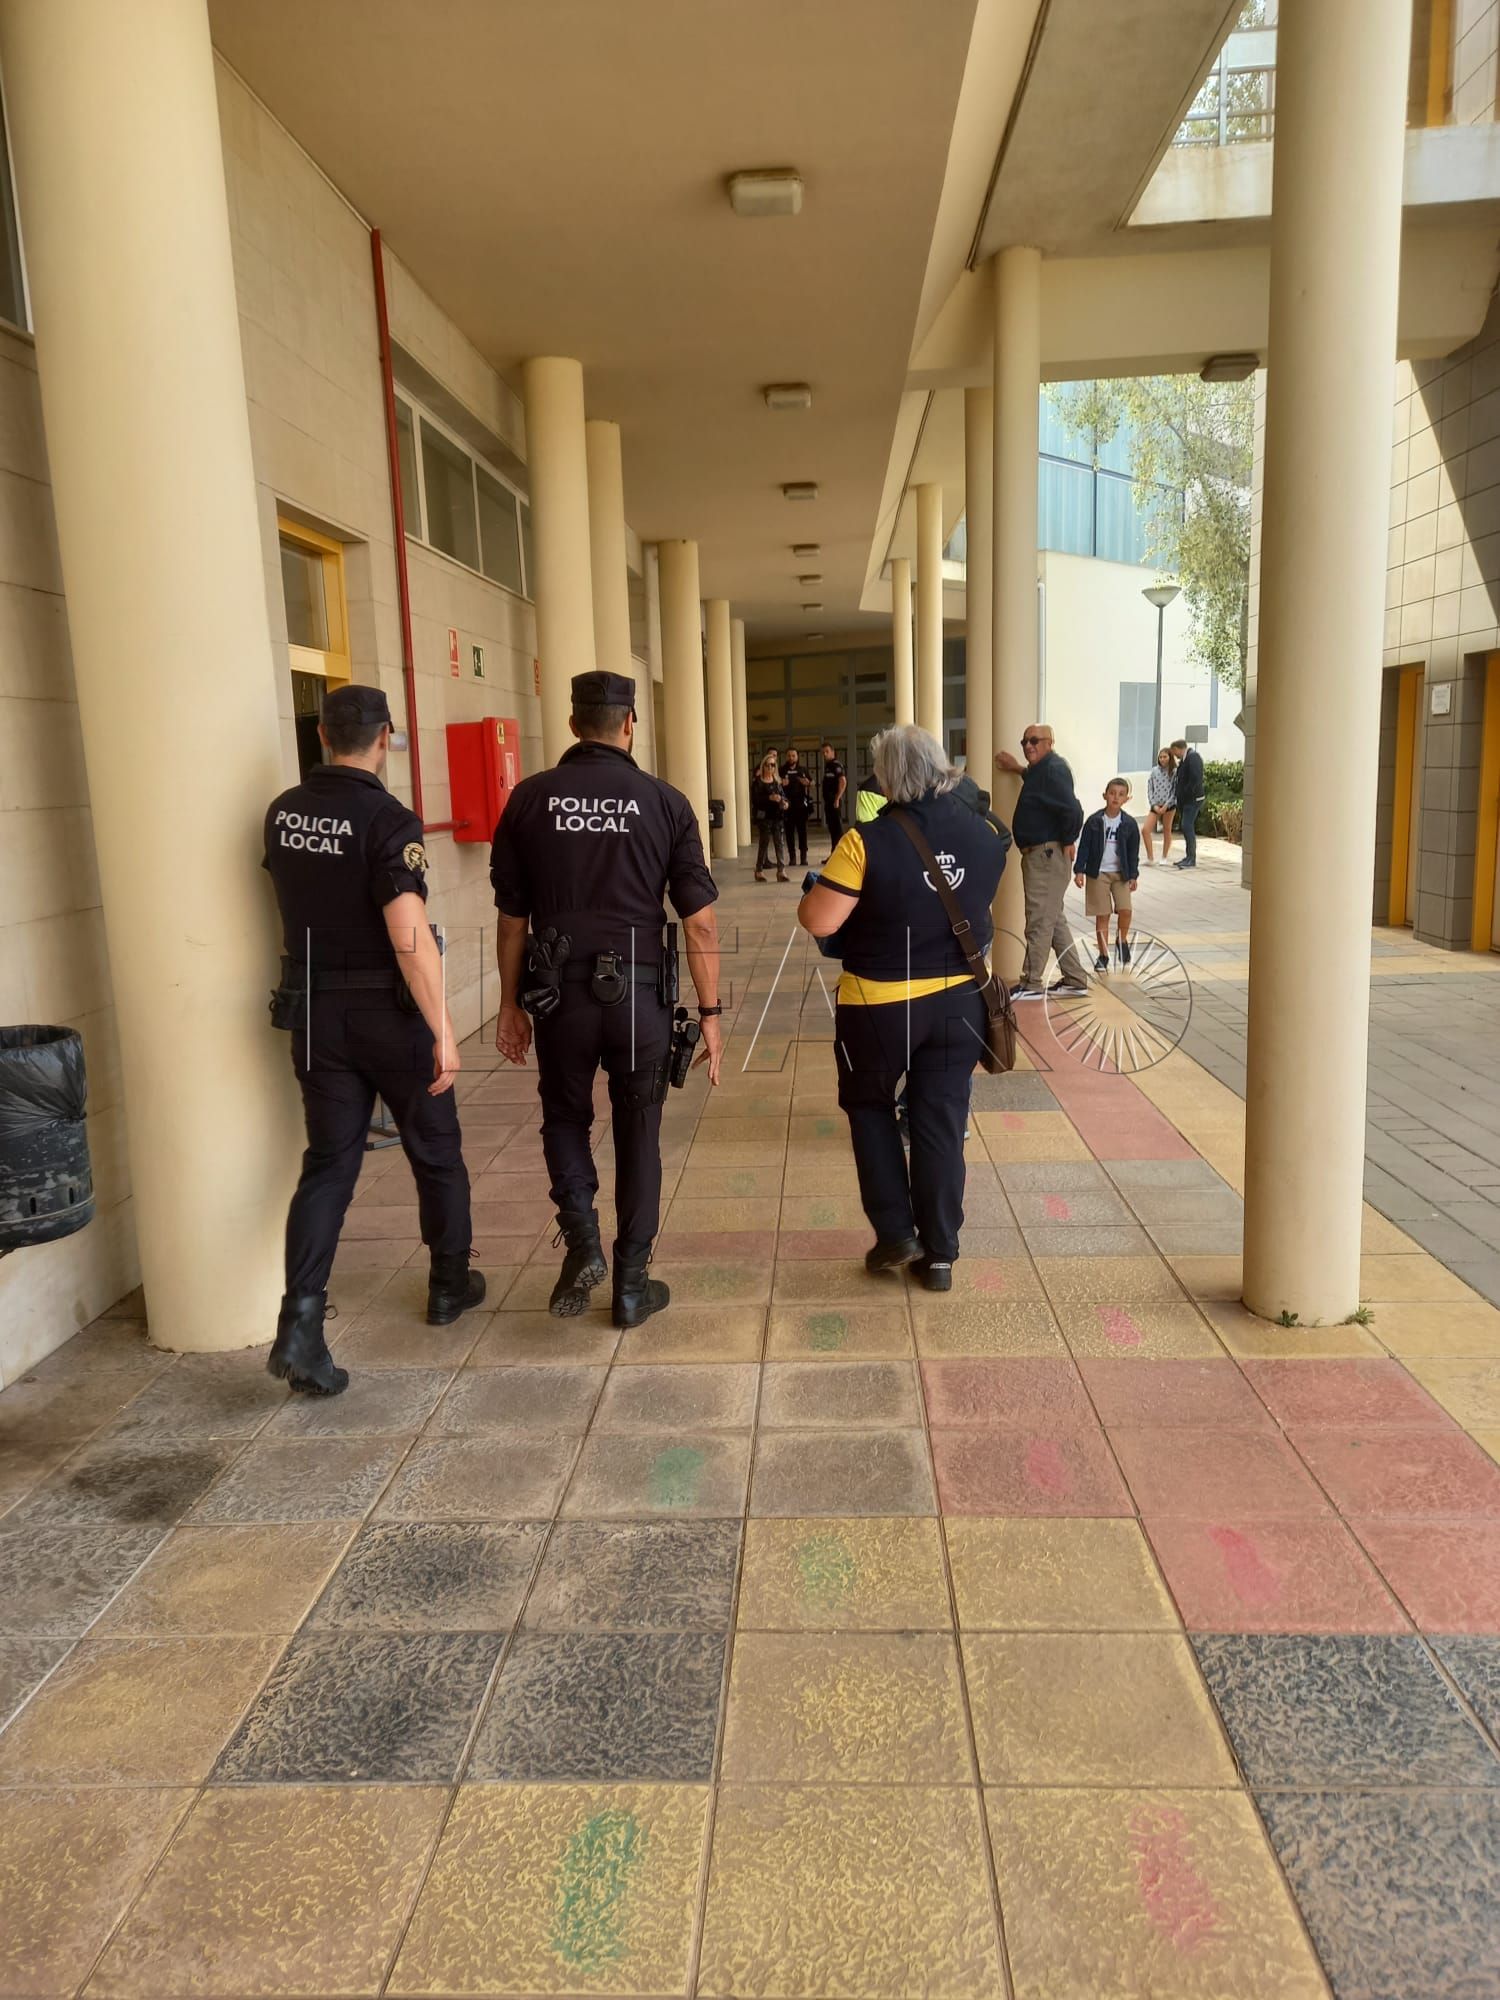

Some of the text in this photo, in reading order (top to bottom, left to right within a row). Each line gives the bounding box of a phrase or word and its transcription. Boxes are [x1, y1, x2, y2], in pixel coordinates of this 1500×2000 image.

[548, 796, 640, 815] POLICIA
[275, 810, 353, 836] POLICIA
[555, 814, 630, 833] LOCAL
[280, 830, 344, 855] LOCAL
